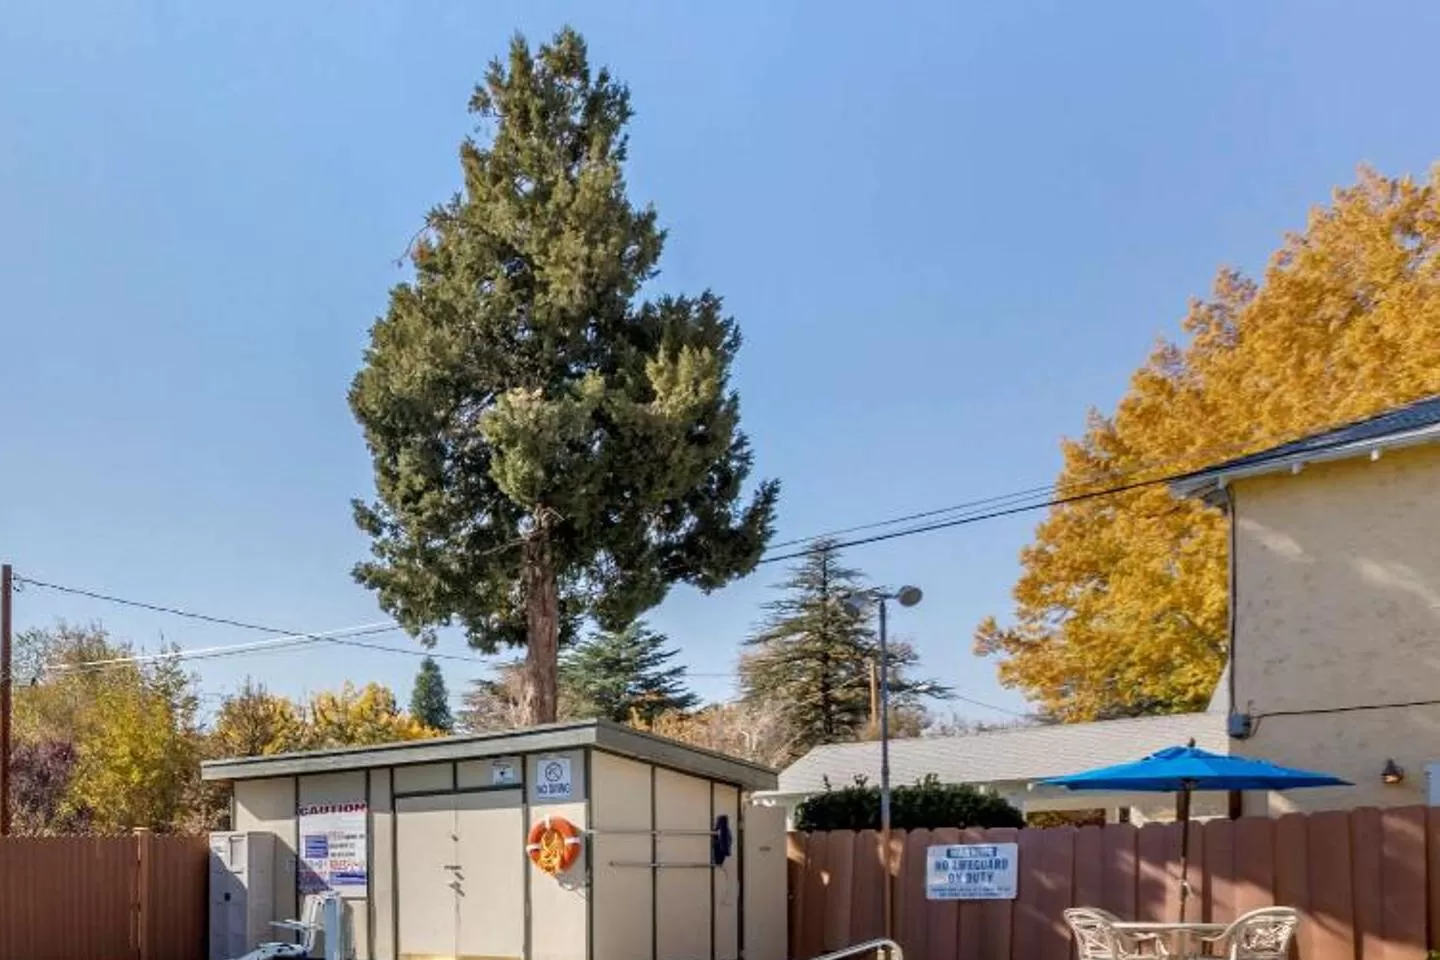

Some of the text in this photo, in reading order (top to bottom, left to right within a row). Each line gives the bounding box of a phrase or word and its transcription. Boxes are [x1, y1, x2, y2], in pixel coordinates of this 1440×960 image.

[298, 803, 365, 816] CAUTION
[935, 858, 1008, 871] NO LIFEGUARD
[965, 872, 993, 884] DUTY
